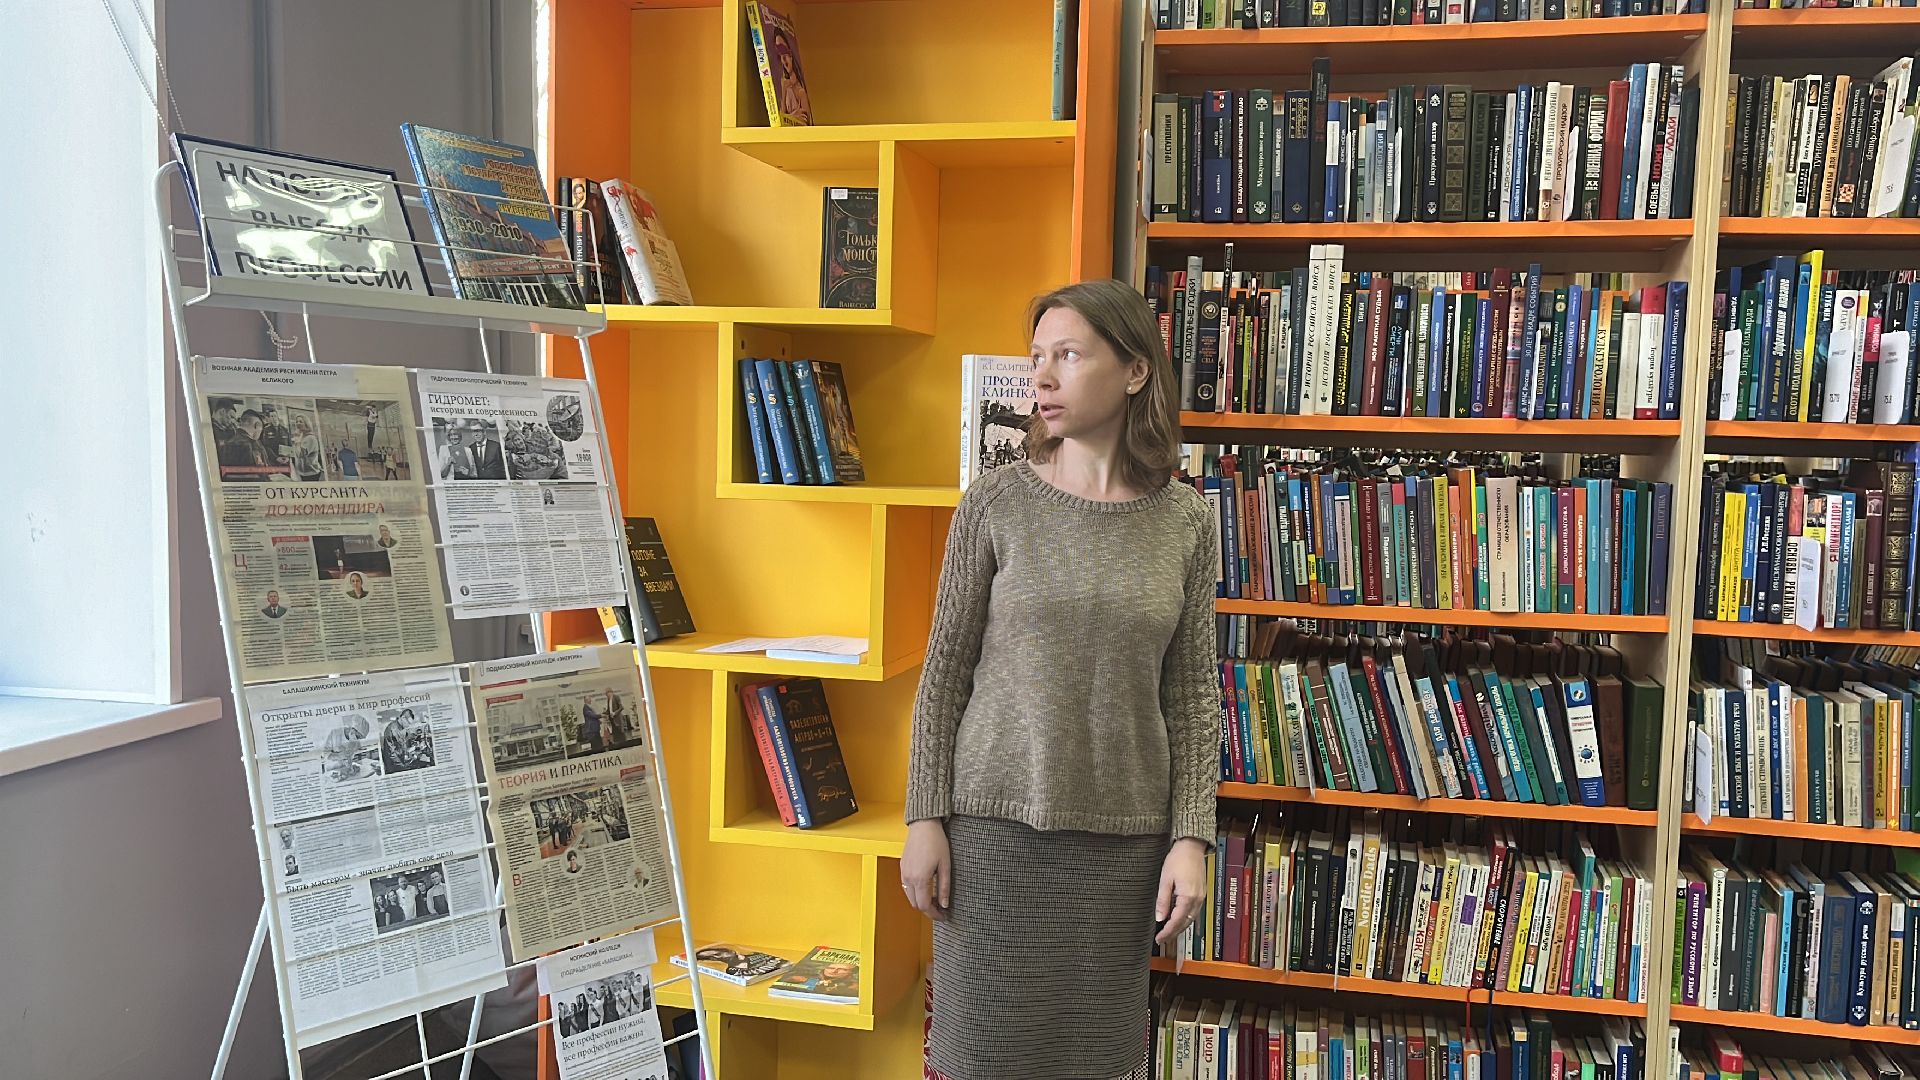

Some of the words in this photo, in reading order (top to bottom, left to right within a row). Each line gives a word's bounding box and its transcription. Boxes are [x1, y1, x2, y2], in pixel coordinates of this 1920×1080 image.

[1817, 82, 1831, 130] ЧЕМПИОНОВ
[1587, 110, 1604, 141] ФОРМА
[1666, 117, 1677, 152] ЛОДКИ
[1830, 113, 1842, 154] НАЧИНАЮЩИХ
[1869, 109, 1881, 134] Роберт
[1164, 114, 1172, 164] ПРЕСТУПЛЕНИЯ
[1813, 132, 1825, 168] ТУРНИРЫ
[1866, 135, 1877, 160] Фишер
[1428, 144, 1436, 185] Прокурорский
[1556, 130, 1566, 180] ПРОКУРОРСКИЙ
[1586, 144, 1602, 178] ВОЕННАЯ
[1653, 144, 1662, 179] НОЖИ
[1828, 157, 1836, 169] ДЛЯ
[1649, 182, 1659, 214] БОЕВЫЕ
[1661, 152, 1672, 214] ПОДВОДНЫЕ
[1824, 171, 1834, 201] ШАХМАТЫ
[453, 216, 484, 236] 1930
[492, 222, 523, 241] 2010
[842, 246, 878, 264] МОНСТ
[1311, 264, 1319, 291] ВОЙСК
[1328, 264, 1336, 290] ВОЙСК
[1529, 275, 1538, 307] СОБЫТИЙ
[1187, 278, 1195, 308] ЛОДКИ
[1374, 290, 1382, 313] СУДЬБА
[1823, 290, 1832, 322] ГЛУБИНА
[1307, 295, 1317, 347] РОССИЙСКИХ
[1325, 295, 1334, 347] РОССИЙСКИХ
[1357, 302, 1365, 322] ТАНКИ
[1528, 309, 1536, 330] КАДРЕ
[1741, 308, 1754, 345] бильярда
[1185, 309, 1195, 363] ПОДВОДНЫЕ
[1871, 323, 1880, 353] РОДНИНА
[1305, 351, 1314, 387] ИСТОРИЯ
[1322, 351, 1330, 387] ИСТОРИЯ
[1592, 329, 1606, 406] КУЛЬТУРОЛОГИЯ
[1741, 347, 1751, 368] мире
[1793, 349, 1803, 375] ВОДОЙ
[983, 375, 1034, 388] ПРОСВЕ
[1792, 376, 1801, 390] ПОД
[1852, 365, 1862, 389] ЛЫЖИ
[428, 394, 491, 406] ГИДРОМЕТ:
[982, 387, 1037, 398] КЛИНКА
[1789, 392, 1799, 415] ОХОТА
[1850, 390, 1860, 419] ГОРНЫЕ
[430, 406, 466, 416] история
[475, 408, 538, 418] современность
[265, 487, 286, 500] ОТ
[291, 486, 369, 499] КУРСАНТА
[265, 505, 288, 518] ДО
[293, 502, 385, 517] КОМАНДИРА
[637, 566, 649, 577] ЗА
[1787, 542, 1797, 574] ОСНОВЫ
[643, 580, 676, 593] ЗВЕЗДАМИ
[1784, 581, 1795, 620] РЕКЛАМЫ
[282, 681, 338, 695] БАЛАШИХИНСКИЙ
[338, 679, 370, 688] ТЕХНИКУМ
[261, 709, 313, 723] Открыты
[315, 705, 346, 718] двери
[357, 701, 378, 711] мир
[380, 693, 431, 708] профессий
[1733, 719, 1741, 749] КУЛЬТУРА
[497, 769, 547, 789] ТЕОРИЯ
[550, 767, 558, 777] И
[561, 755, 622, 777] ПРАКТИКА
[1758, 735, 1766, 782] СПРАВОЧНИК
[286, 881, 309, 894] Быть
[311, 873, 350, 889] мастером
[358, 865, 387, 878] значит
[387, 857, 417, 871] любить
[436, 850, 454, 862] дело
[1363, 847, 1376, 880] Dads
[1227, 877, 1237, 919] Логопедия
[1358, 883, 1372, 928] Nordic
[1692, 932, 1697, 940] ПО
[1688, 942, 1696, 974] РУССКОМУ
[1856, 967, 1866, 996] Культура
[561, 1039, 575, 1050] Все
[576, 1028, 617, 1049] профессии
[563, 1053, 576, 1063] все
[577, 1039, 618, 1060] профессии
[619, 1030, 644, 1044] важны
[1203, 1035, 1213, 1063] СПОК
